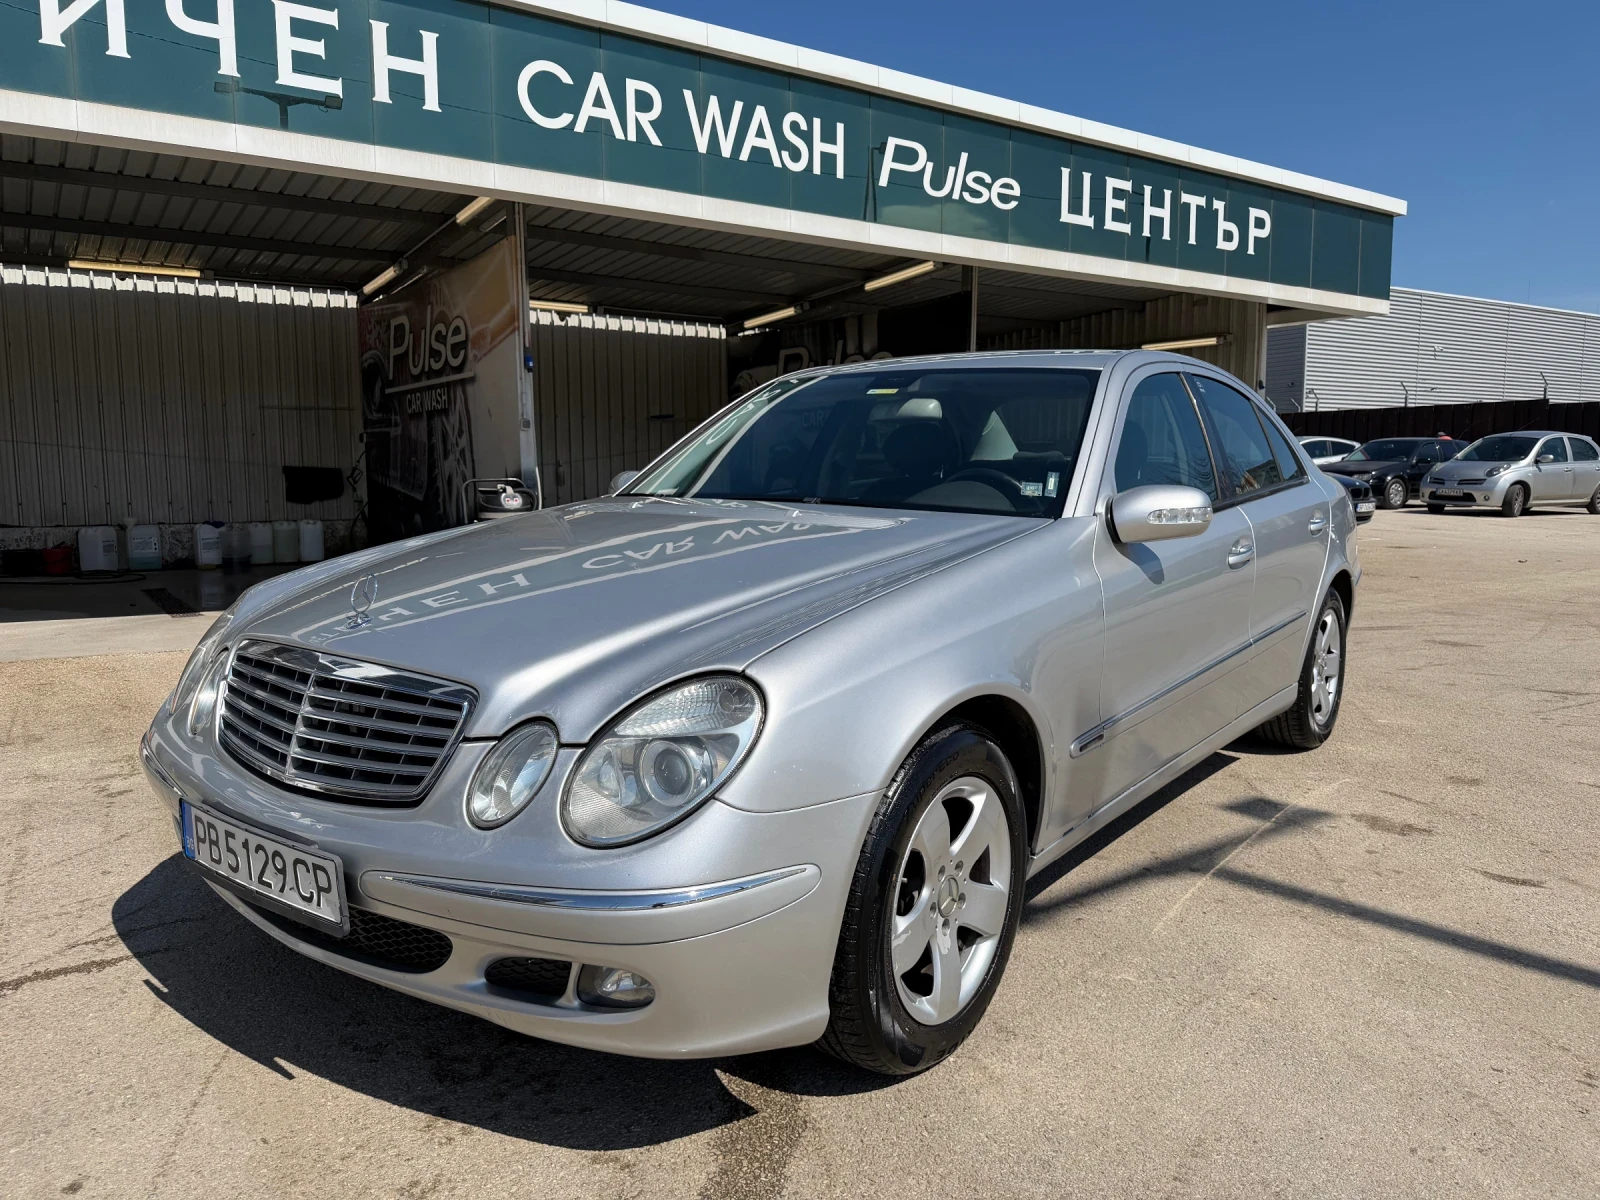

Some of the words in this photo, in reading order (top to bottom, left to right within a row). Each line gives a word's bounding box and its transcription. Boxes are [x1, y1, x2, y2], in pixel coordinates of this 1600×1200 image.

[517, 59, 663, 147] CAR
[682, 88, 845, 180] WASH
[878, 136, 1021, 210] Pulse
[1059, 166, 1272, 255] ЦЕНТЪР
[389, 304, 466, 381] Pulse
[406, 393, 422, 414] CAR
[423, 387, 448, 412] WASH
